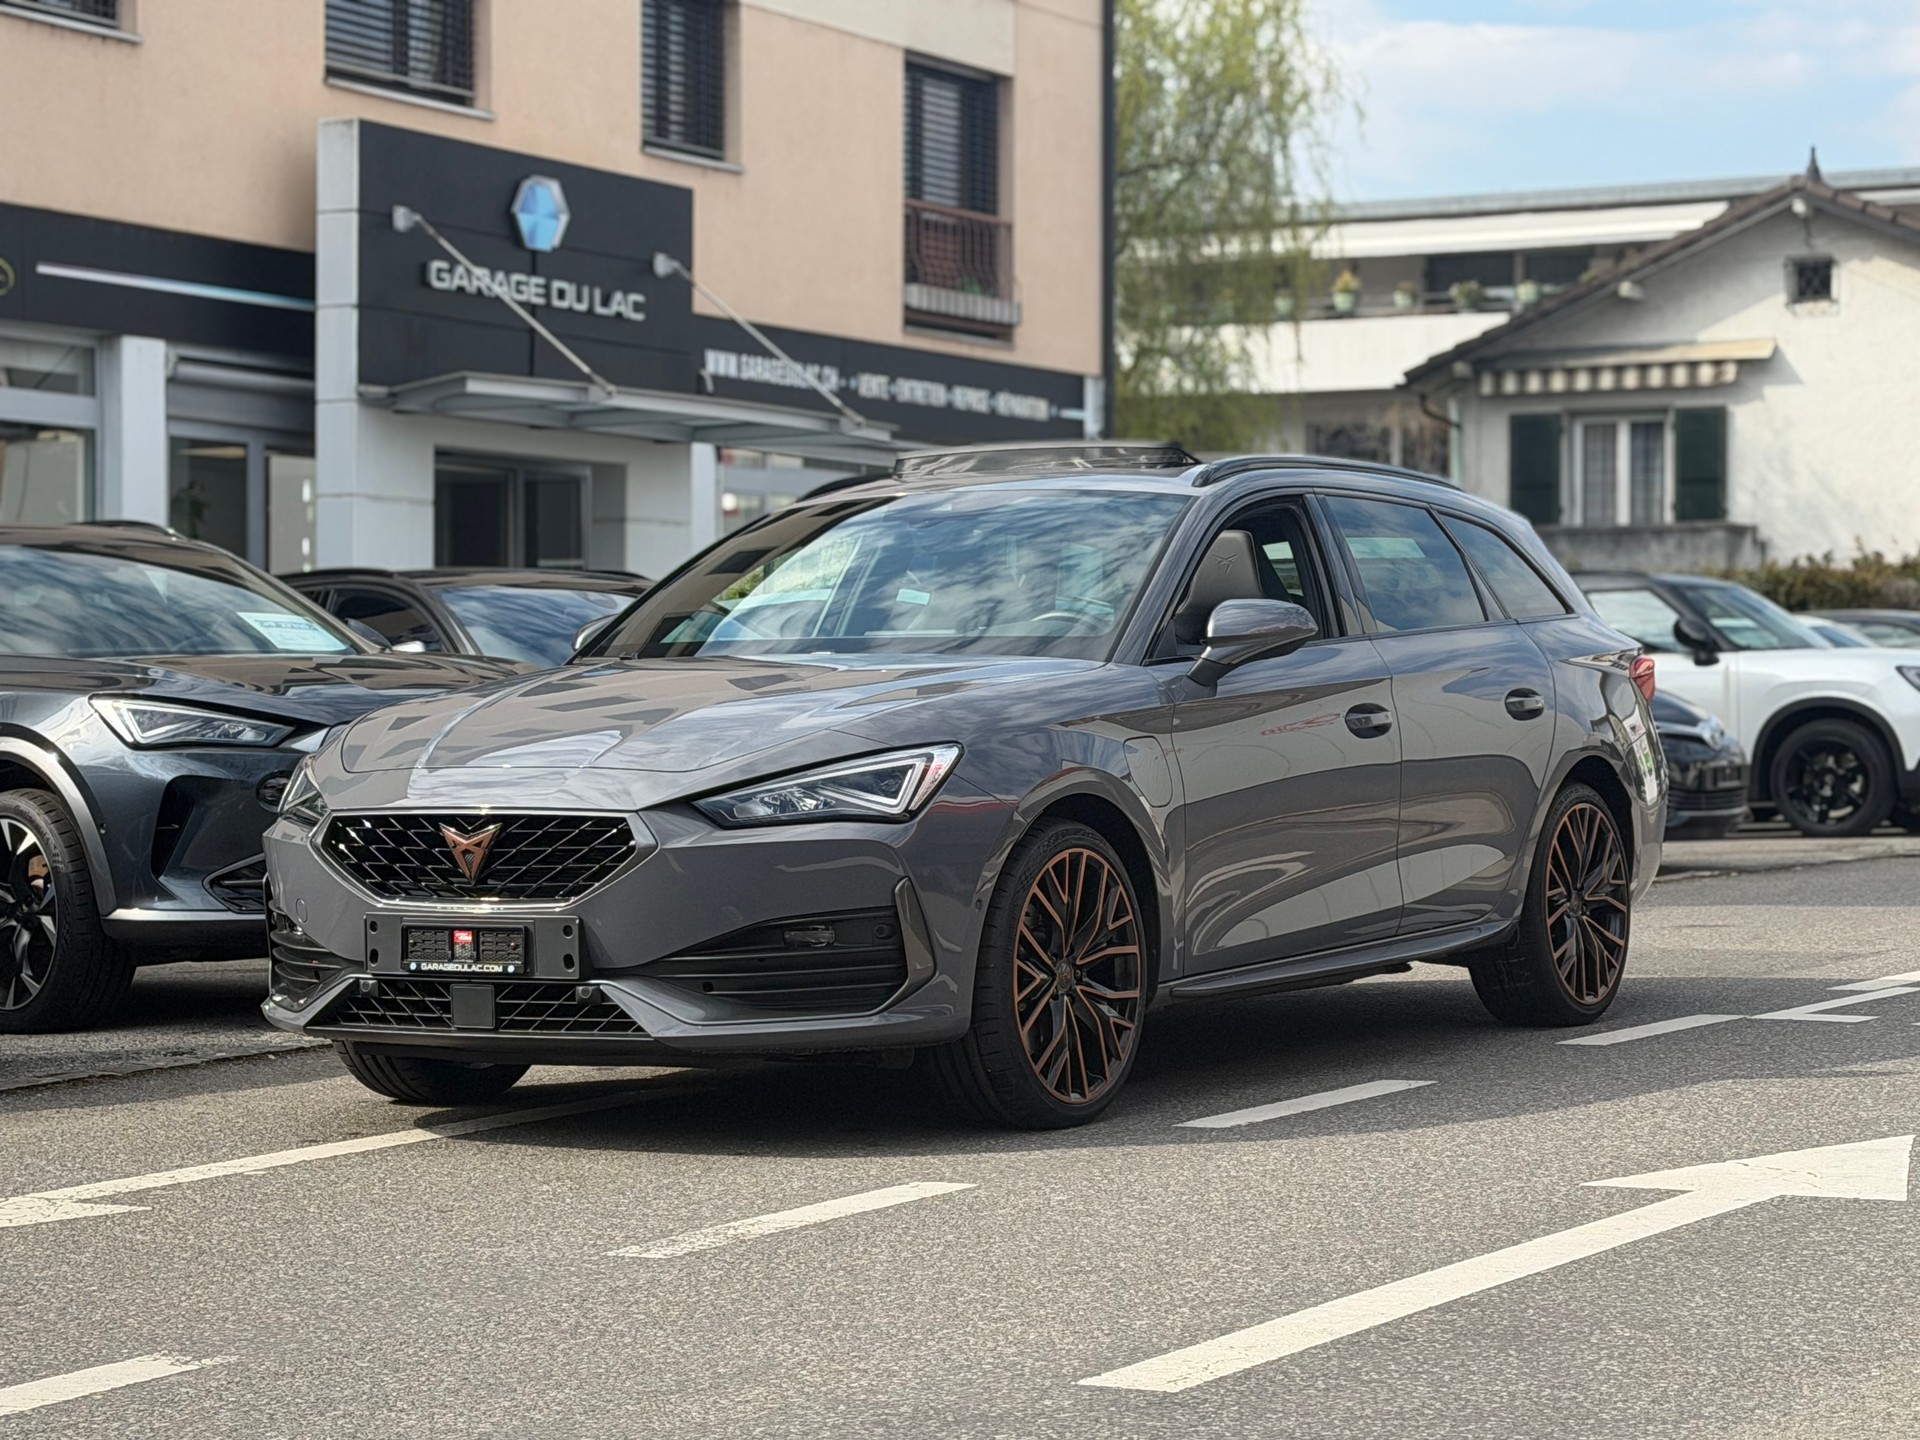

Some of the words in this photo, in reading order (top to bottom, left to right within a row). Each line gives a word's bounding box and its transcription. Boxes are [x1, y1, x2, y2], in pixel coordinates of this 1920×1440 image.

[427, 259, 547, 306] GARAGE
[551, 280, 589, 312] DU
[593, 286, 646, 321] LAC
[421, 962, 503, 973] GARAGEDULAC.COM
